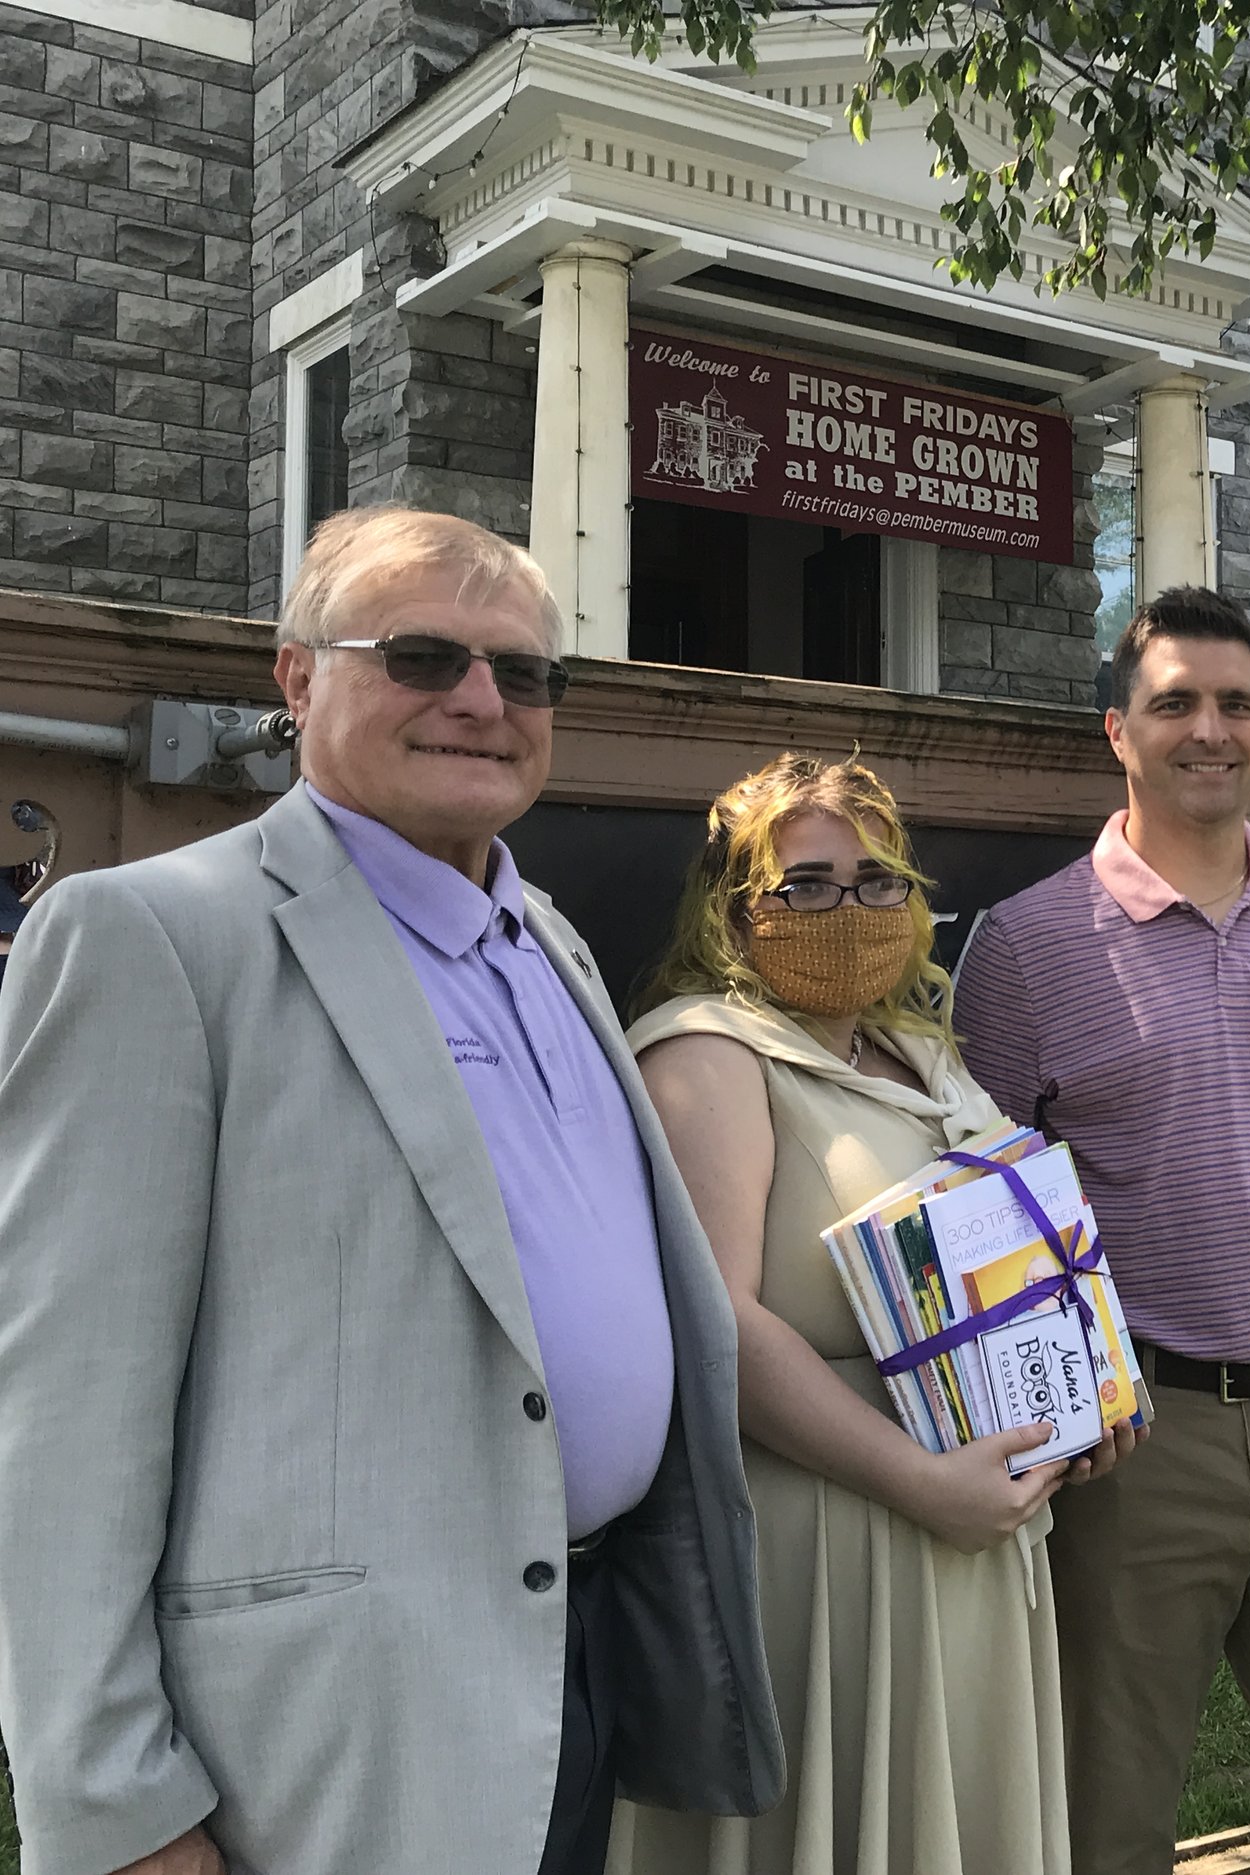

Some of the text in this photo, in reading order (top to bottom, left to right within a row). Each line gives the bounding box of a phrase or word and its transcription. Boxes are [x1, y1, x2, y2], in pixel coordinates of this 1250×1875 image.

[644, 341, 771, 384] Welcome to
[788, 372, 1039, 450] FIRST FRIDAYS
[785, 408, 1040, 491] HOME GROWN
[781, 489, 1041, 549] firstfridays@pembermuseum.com
[784, 459, 1040, 522] at the PEMBER
[445, 1037, 481, 1048] Florida
[454, 1053, 501, 1066] a-friendly
[947, 1187, 1061, 1245] 300 TIPS OR
[951, 1205, 1080, 1268] MAKING LIFE SIER
[1000, 1350, 1023, 1426] FOUNDATI
[1051, 1340, 1091, 1415] Nana's
